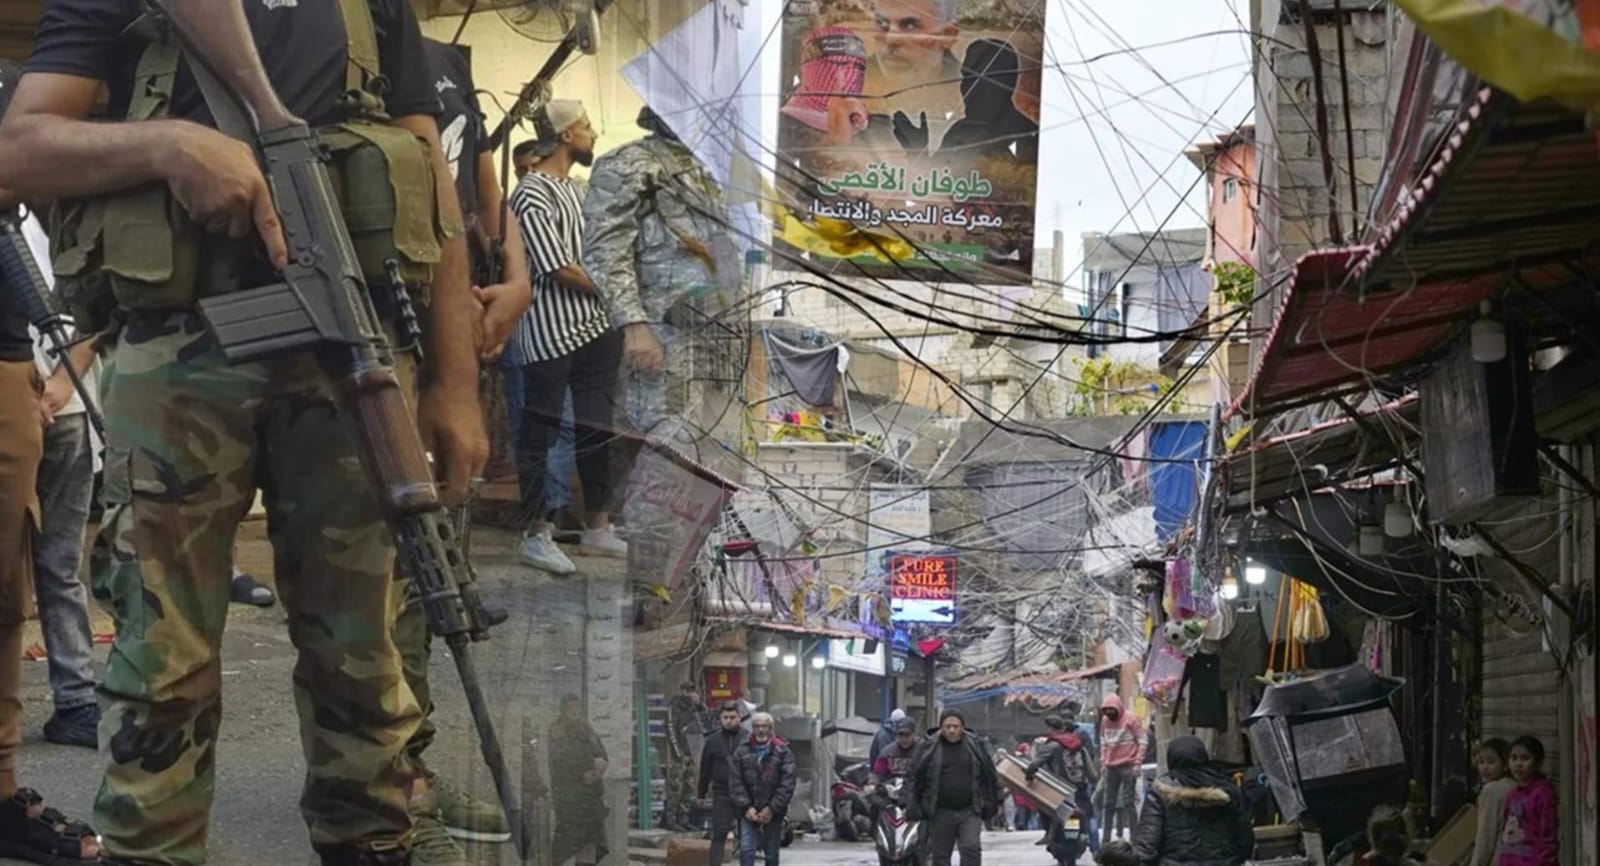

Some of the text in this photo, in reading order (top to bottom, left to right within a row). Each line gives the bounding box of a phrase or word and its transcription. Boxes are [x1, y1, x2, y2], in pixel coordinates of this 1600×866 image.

[817, 162, 992, 201] طوفان الأقصى
[886, 205, 937, 226] المجد
[942, 207, 1003, 230] معركة
[903, 559, 945, 572] PURE
[898, 573, 947, 585] SMILE
[896, 586, 950, 598] CLINIC
